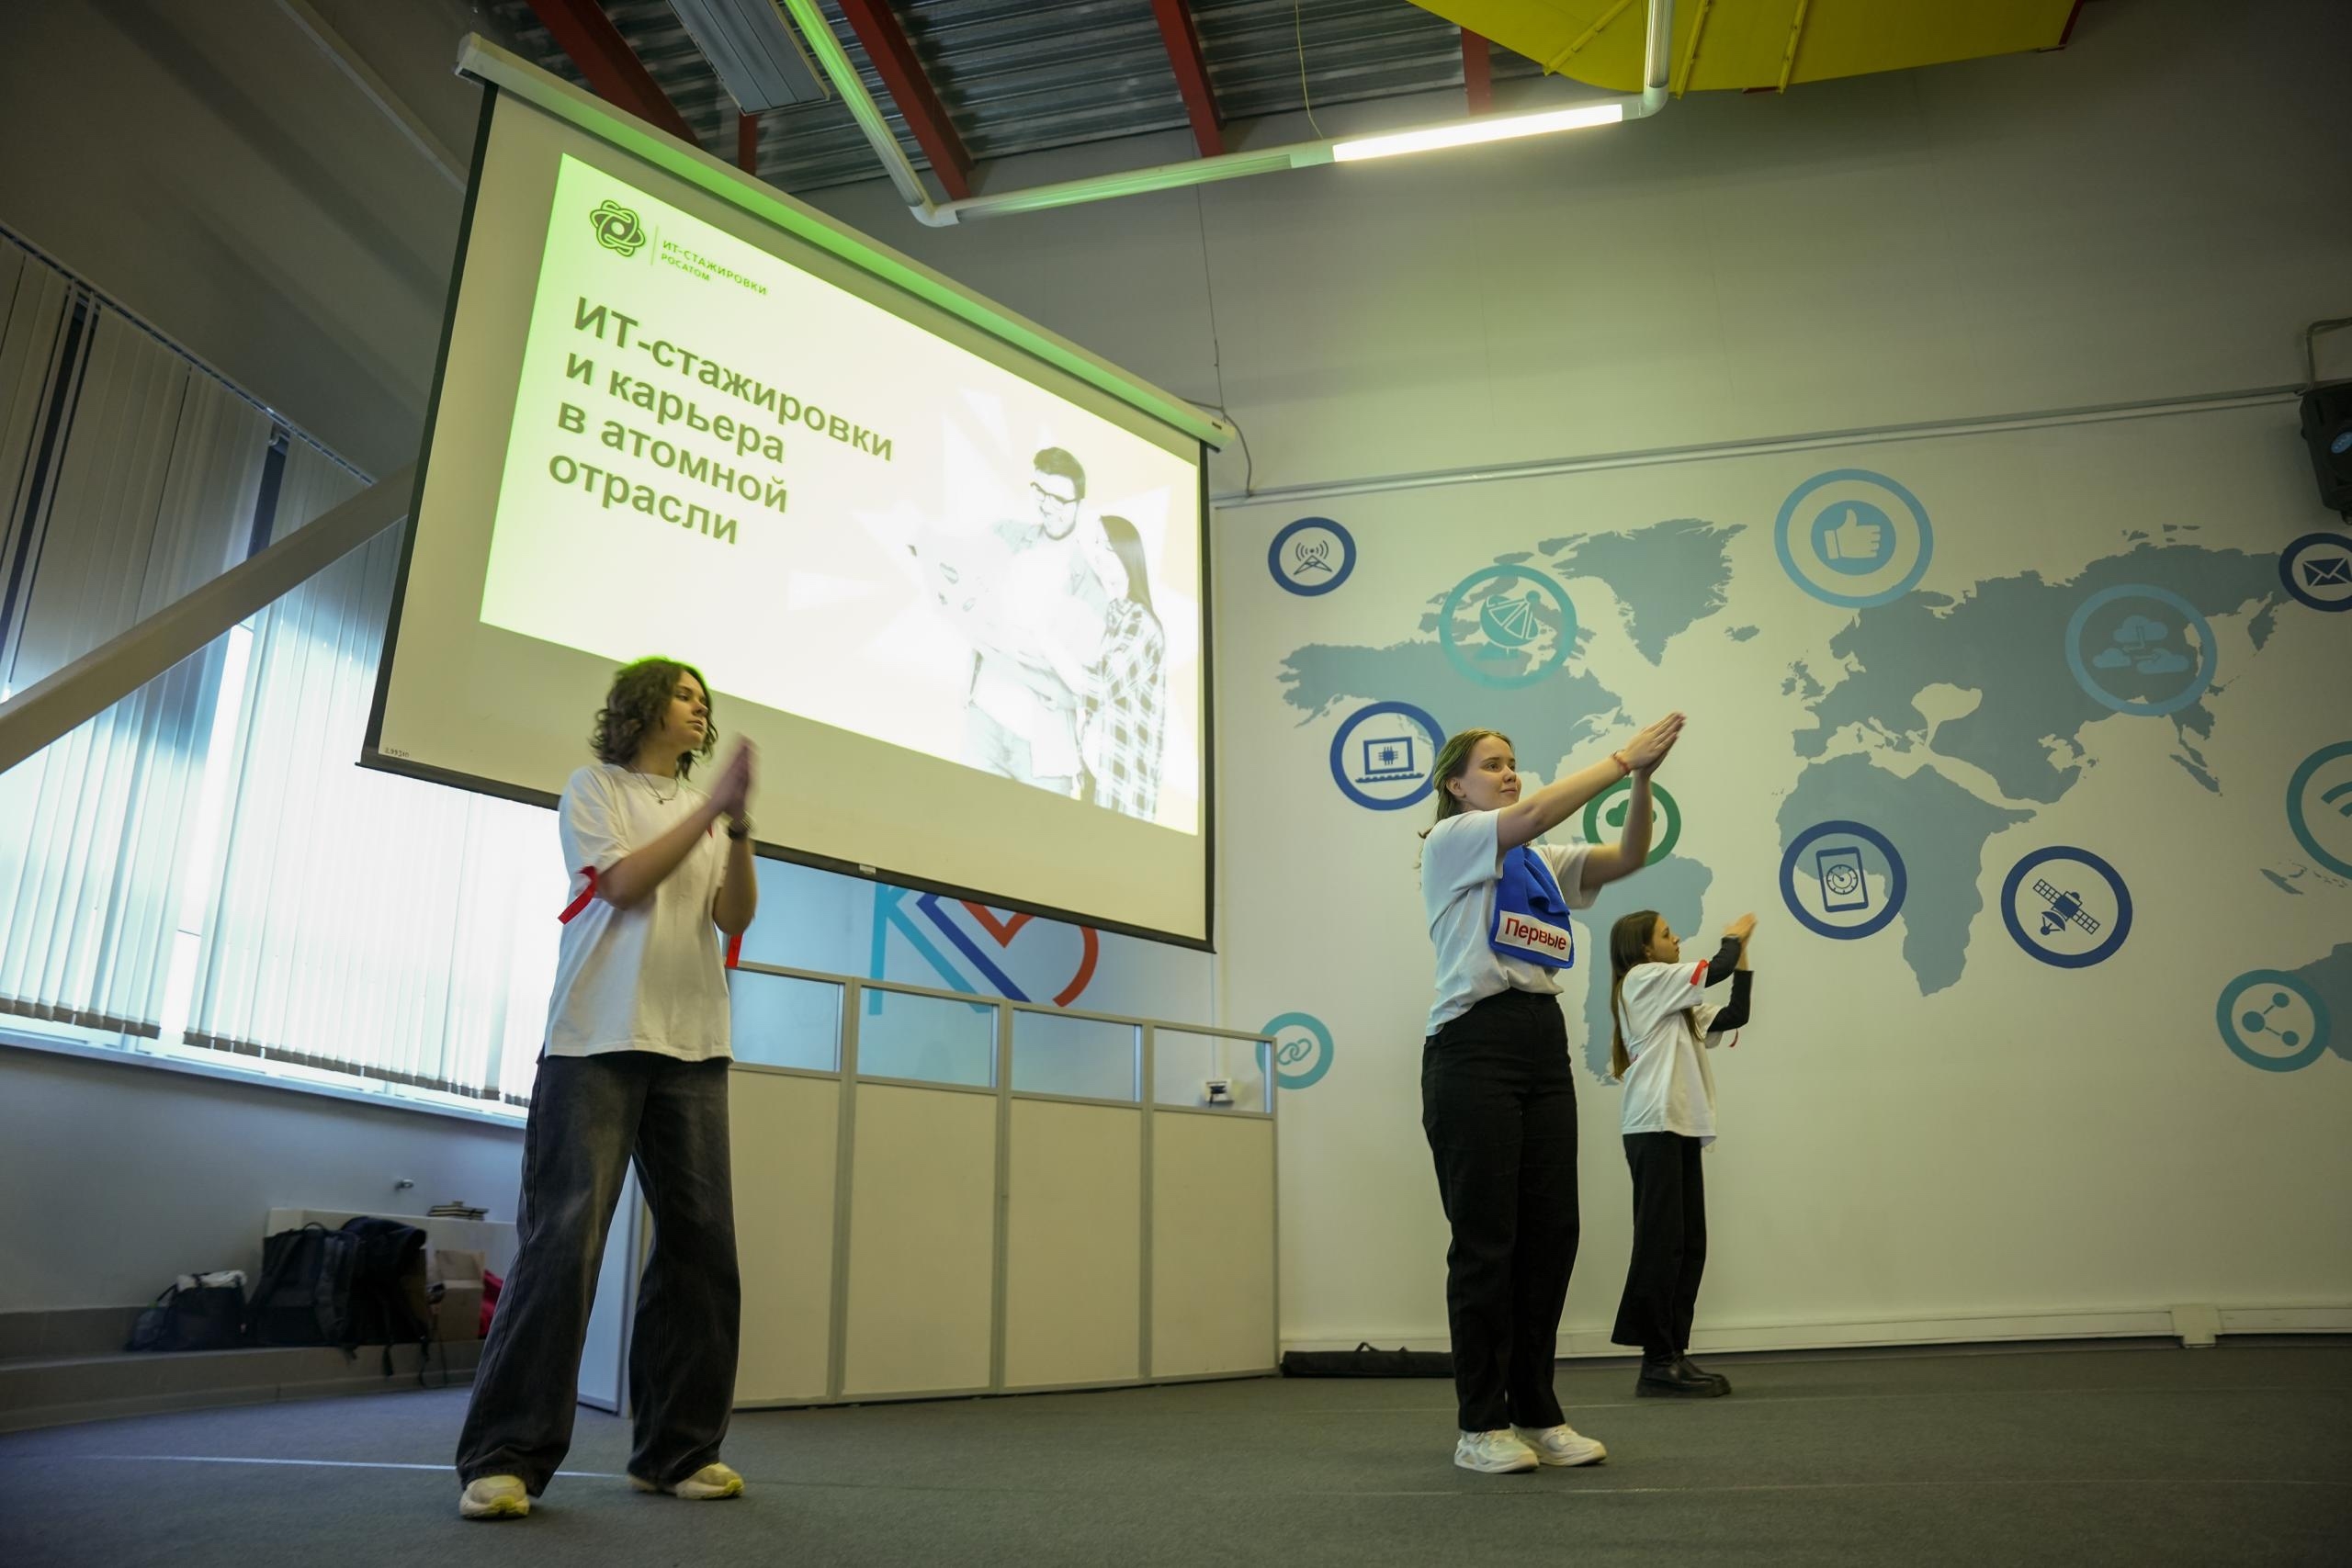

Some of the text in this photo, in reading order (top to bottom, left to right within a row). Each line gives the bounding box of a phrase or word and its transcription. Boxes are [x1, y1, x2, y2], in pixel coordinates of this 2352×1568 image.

[661, 253, 710, 281] РОСАТОМ
[662, 240, 767, 295] ИТ-СТАЖИРОВКИ
[565, 352, 784, 463] и карьера
[573, 296, 893, 462] ИТ-стажировки
[548, 454, 738, 545] отрасли
[558, 401, 787, 513] в атомной
[1505, 917, 1566, 951] Первые
